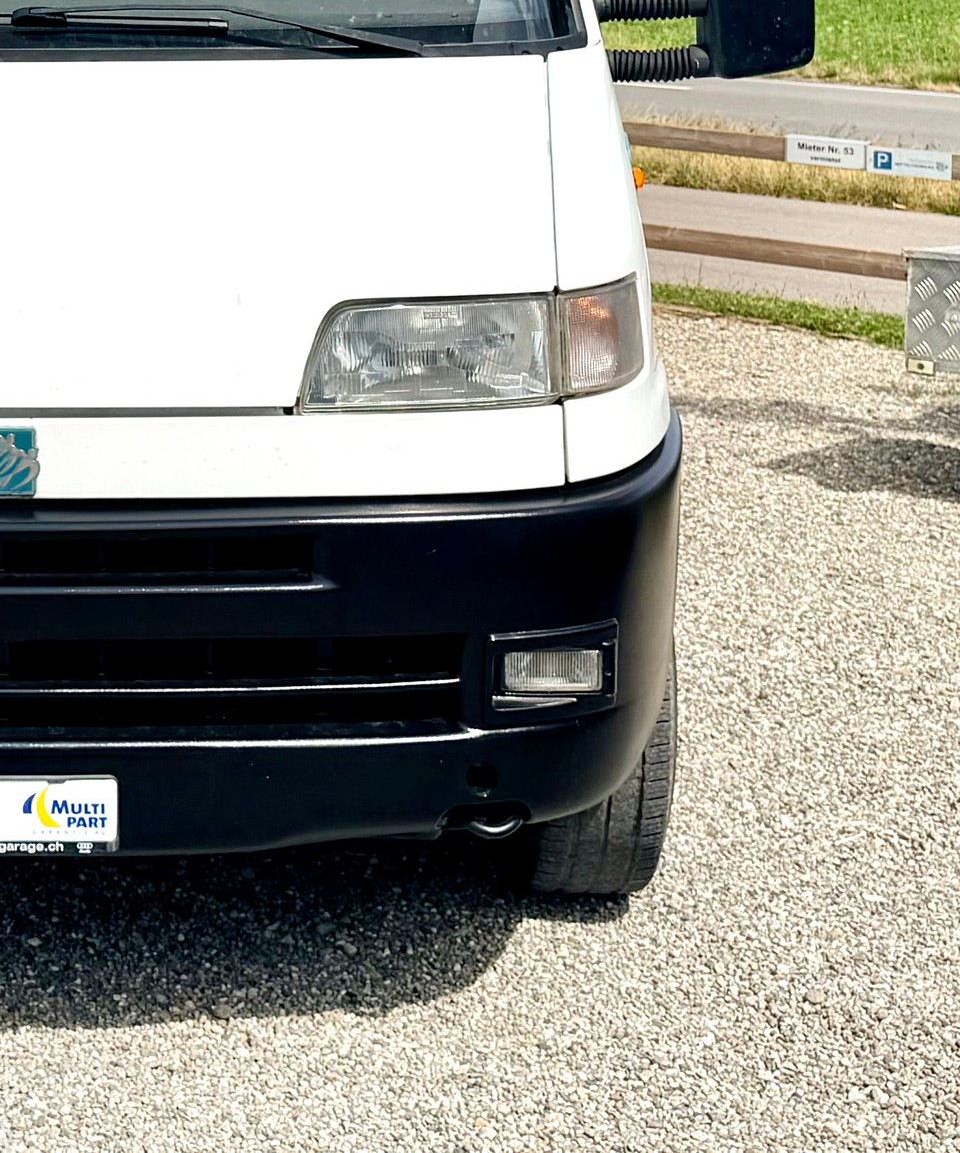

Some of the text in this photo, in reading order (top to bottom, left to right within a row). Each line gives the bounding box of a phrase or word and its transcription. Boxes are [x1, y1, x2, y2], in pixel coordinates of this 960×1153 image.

[797, 142, 854, 155] Mieter Nr. 53
[877, 152, 889, 168] P
[67, 817, 107, 828] PART
